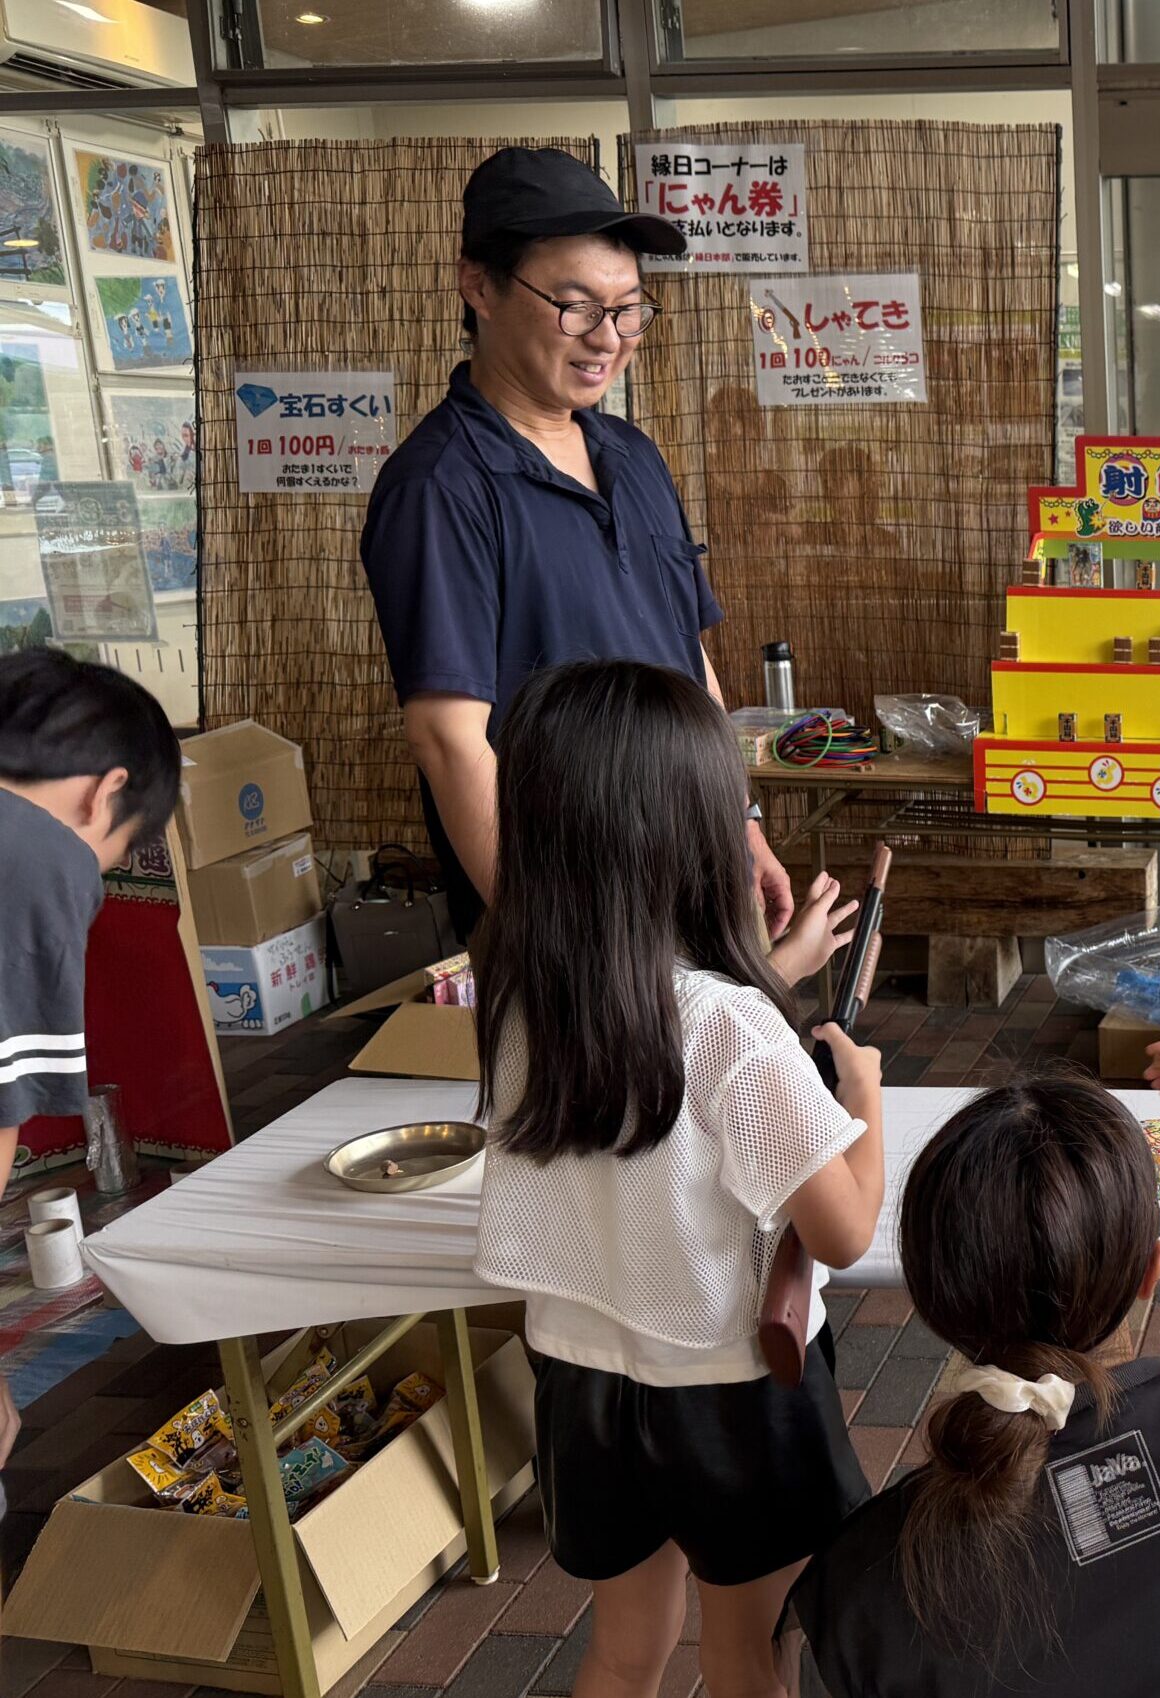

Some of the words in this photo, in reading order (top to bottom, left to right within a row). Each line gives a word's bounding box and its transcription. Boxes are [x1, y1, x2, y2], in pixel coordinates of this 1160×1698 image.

[651, 155, 788, 176] 縁日コーナーは
[804, 300, 910, 332] しゃてき
[783, 371, 897, 385] たおすことできなくても
[279, 393, 391, 418] 宝石すくい
